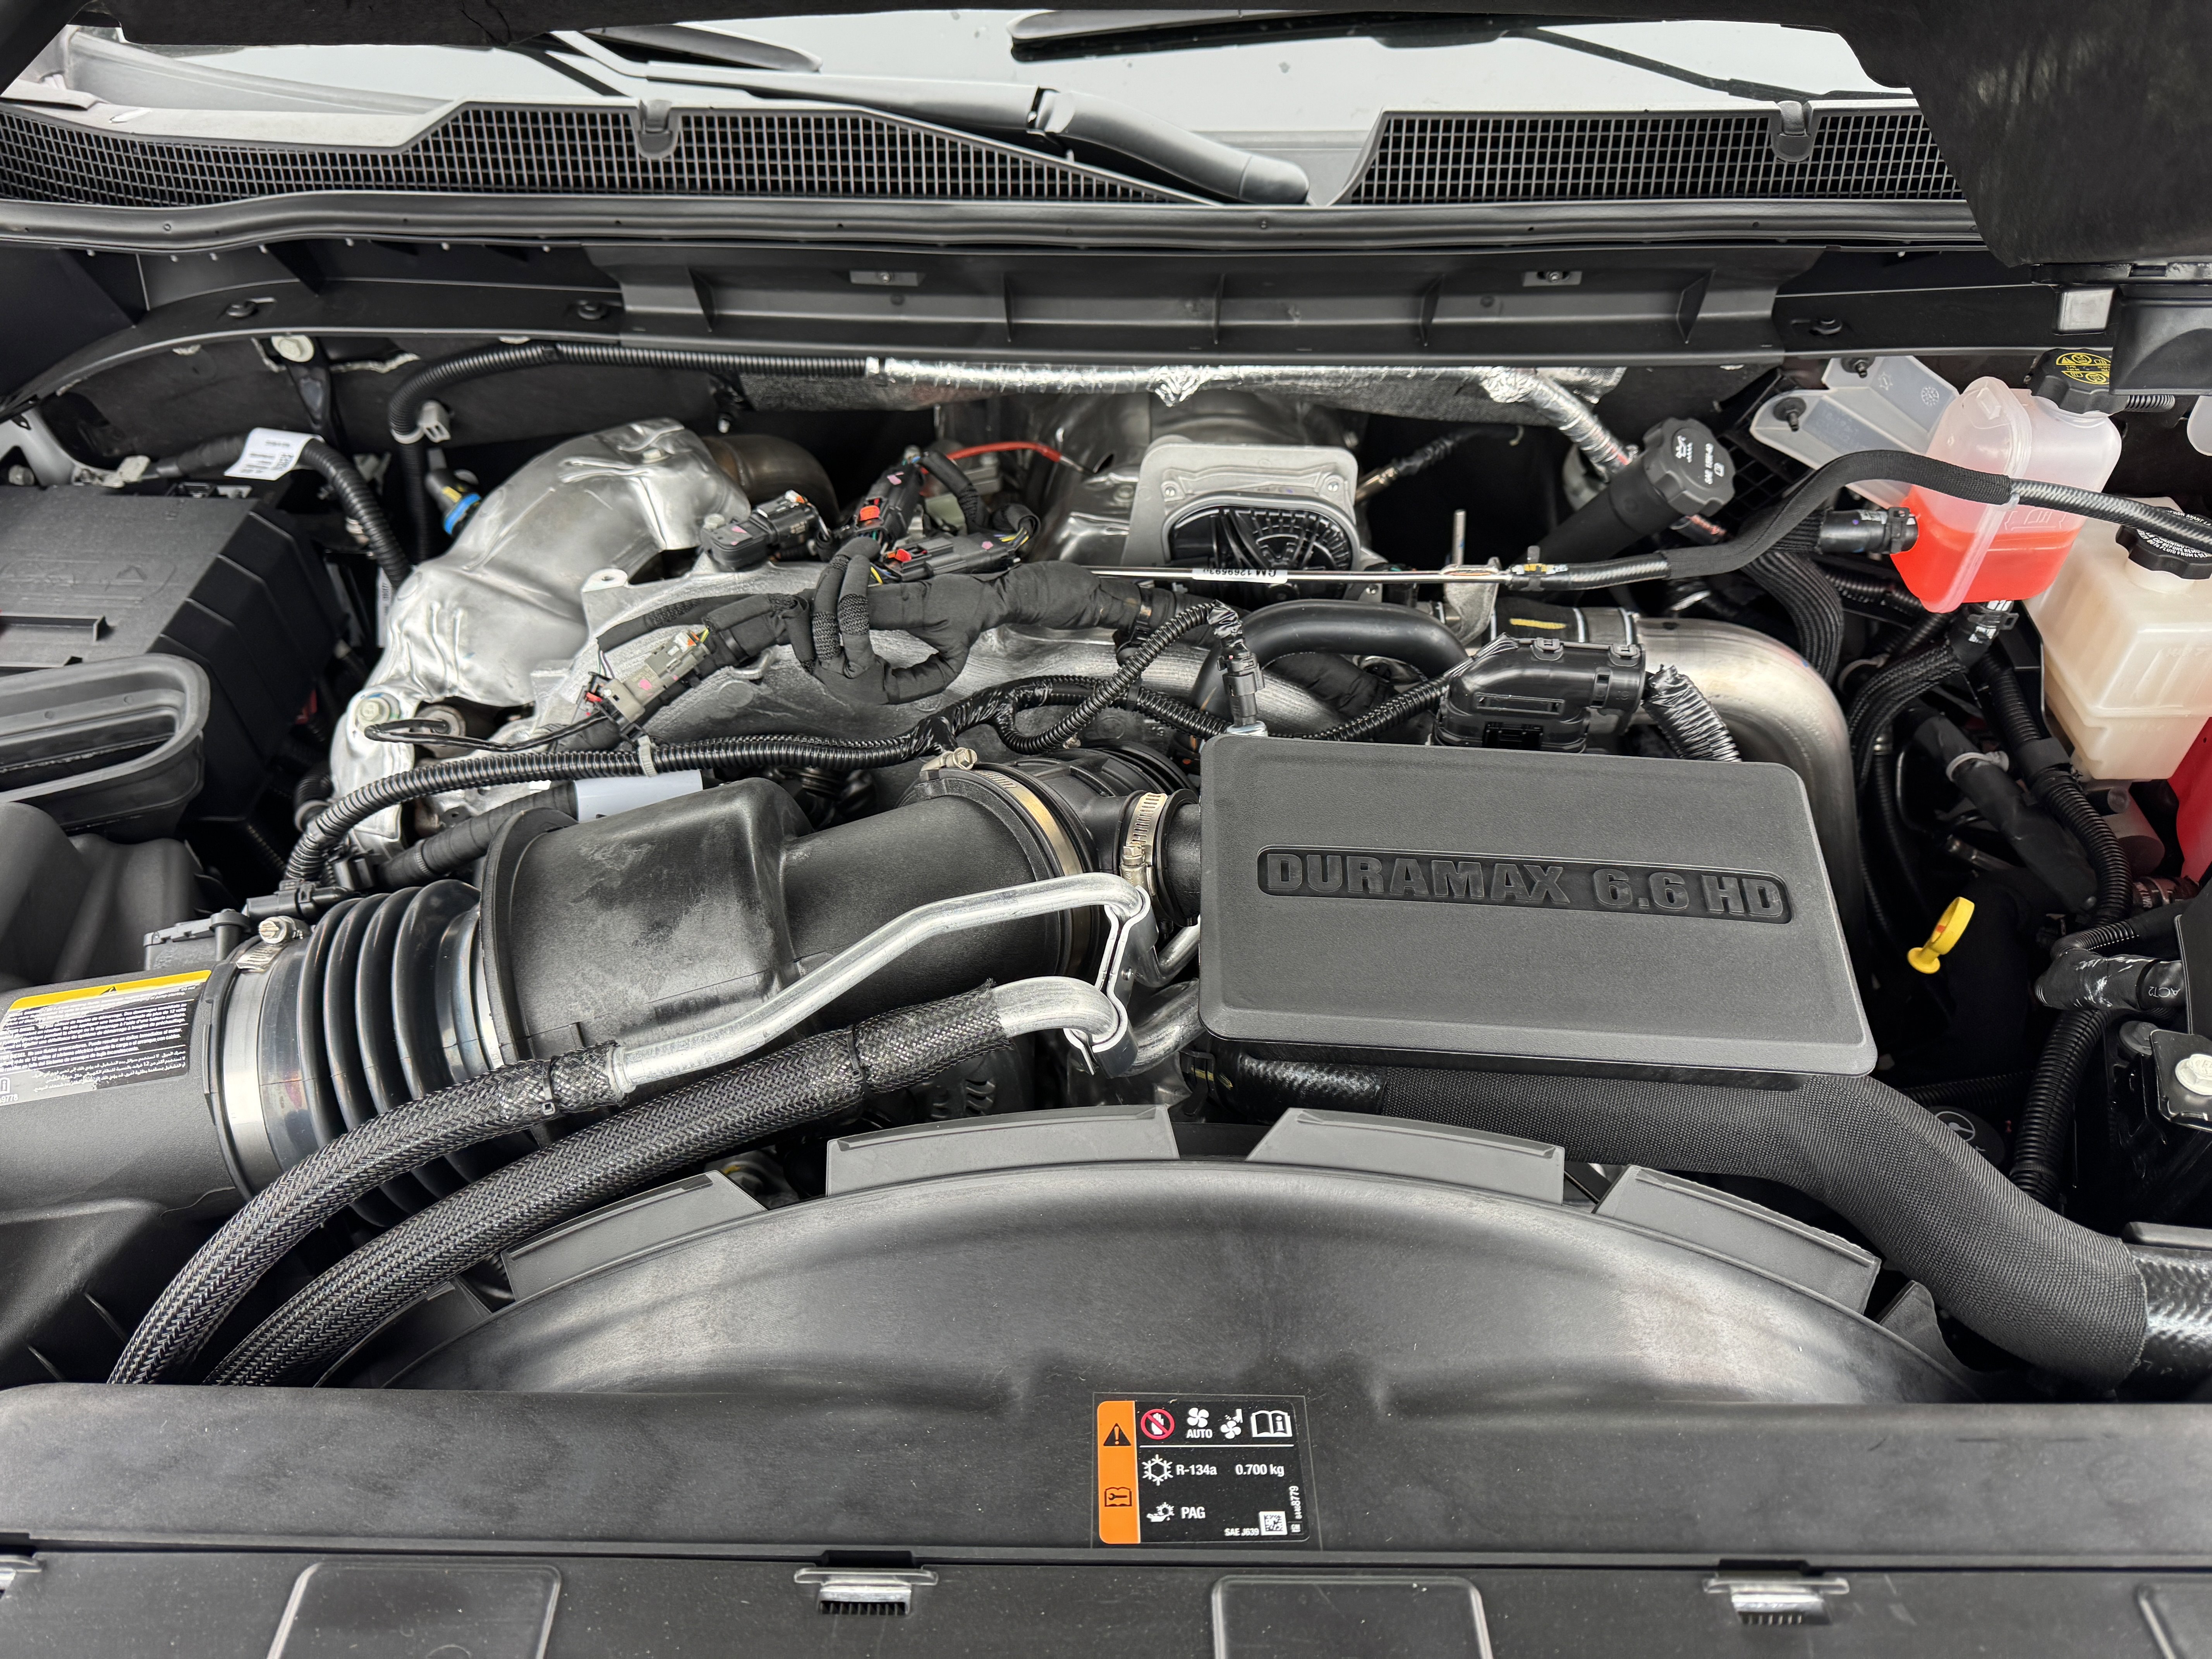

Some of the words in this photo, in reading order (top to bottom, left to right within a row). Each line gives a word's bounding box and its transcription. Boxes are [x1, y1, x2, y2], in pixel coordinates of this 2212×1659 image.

[2162, 543, 2183, 551] BEFORE
[1267, 853, 1570, 904] DURAMAX
[1592, 868, 1689, 911] 6.6
[1705, 874, 1784, 918] HD
[2148, 986, 2181, 998] ACT2
[1186, 1429, 1213, 1439] AUTO
[1176, 1464, 1217, 1475] R-134a
[1235, 1464, 1268, 1475] 0.700
[1269, 1464, 1285, 1477] kg
[1181, 1507, 1206, 1519] PAG
[1224, 1528, 1240, 1536] SAE
[1241, 1528, 1260, 1536] J639
